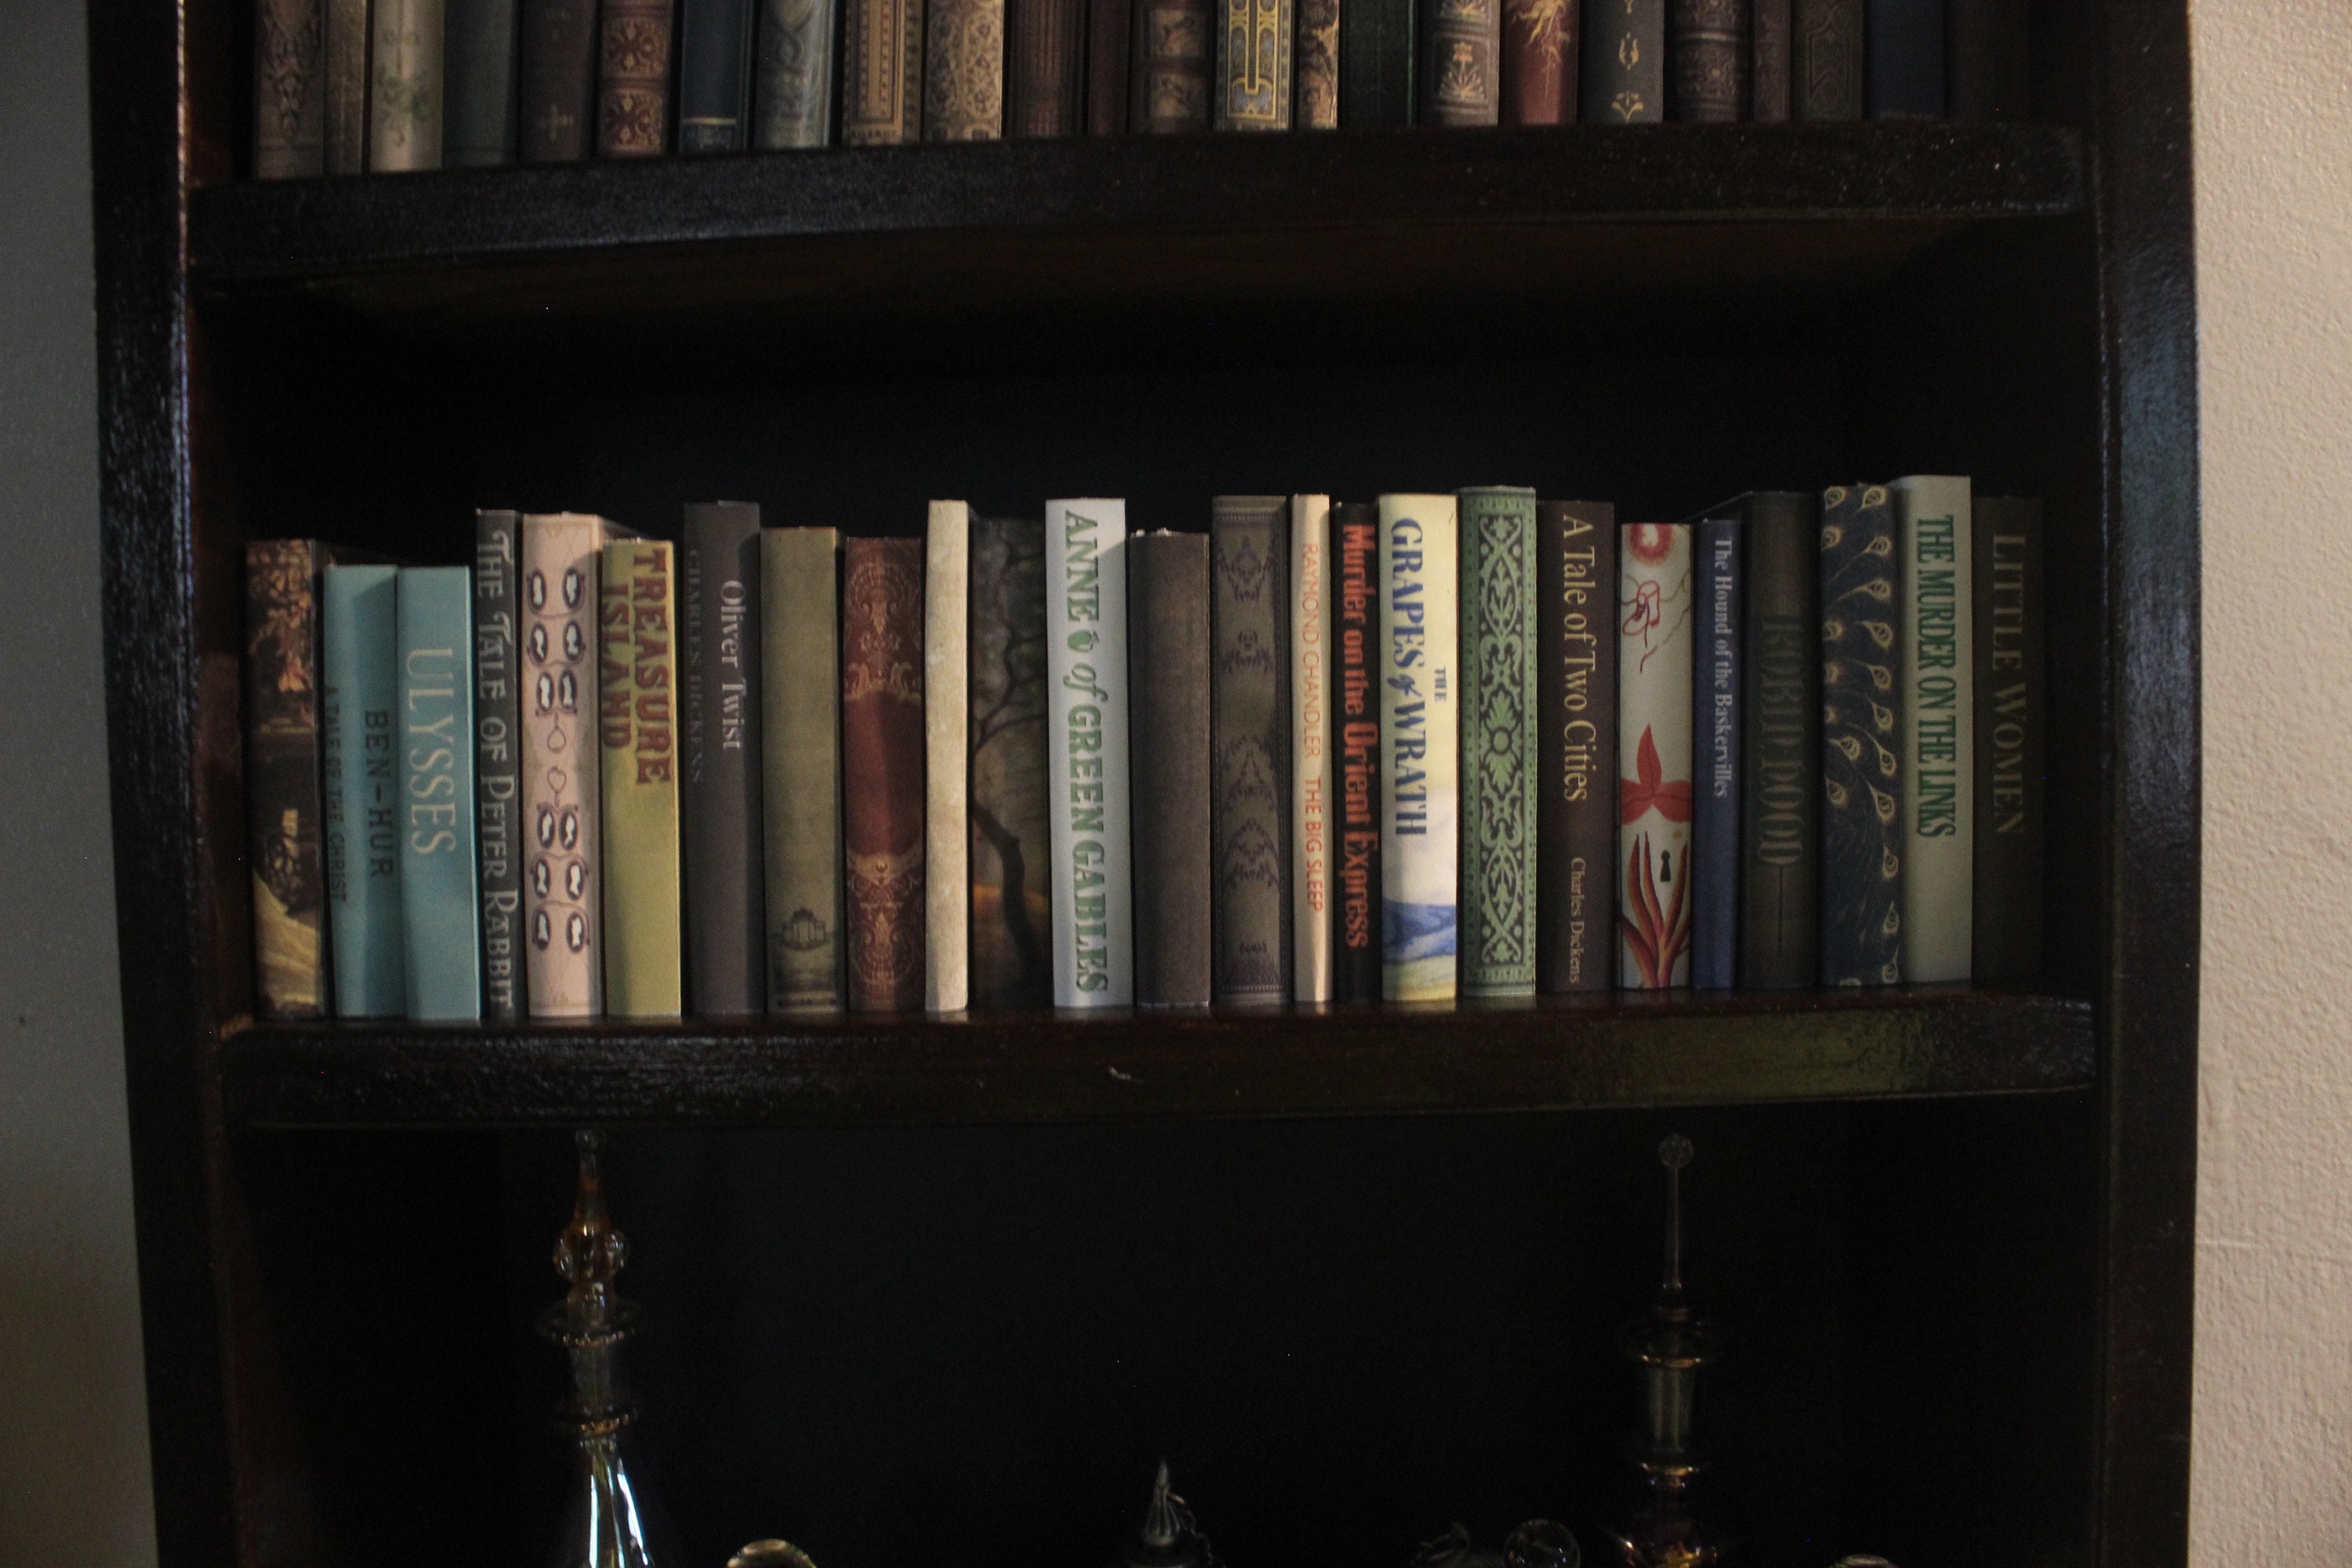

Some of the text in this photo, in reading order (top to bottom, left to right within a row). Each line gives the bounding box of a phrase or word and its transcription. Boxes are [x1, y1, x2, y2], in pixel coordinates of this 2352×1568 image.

[602, 583, 630, 748] ISLAND
[633, 549, 671, 783] TREASURE
[688, 549, 704, 783] CHARLES DICKENS
[720, 580, 747, 750] Oliver Twist
[1391, 518, 1425, 669] GRAPES
[1434, 666, 1447, 702] THE
[1563, 514, 1597, 801] A Tale of Two Cities
[1714, 539, 1733, 798] The Hound of the Baskervilles
[1918, 514, 1956, 837] THE MURDER ON THE LINKS
[1992, 535, 2027, 834] LITTLE WOMEN
[328, 790, 343, 822] THE
[365, 710, 393, 878] BEN-HUR
[407, 648, 456, 855] ULYSSES
[477, 529, 518, 1008] THE TALE OF PETER RABBIT
[1063, 510, 1108, 993] ANNE of GREEN GABLES
[1302, 544, 1323, 911] RAYMOND CHANDLER THE BIG SLEEP
[1341, 524, 1378, 949] Murder on the Orient Express
[1394, 699, 1428, 835] WRATH
[329, 833, 347, 902] CHRIST
[1569, 857, 1586, 984] Charles Dickens
